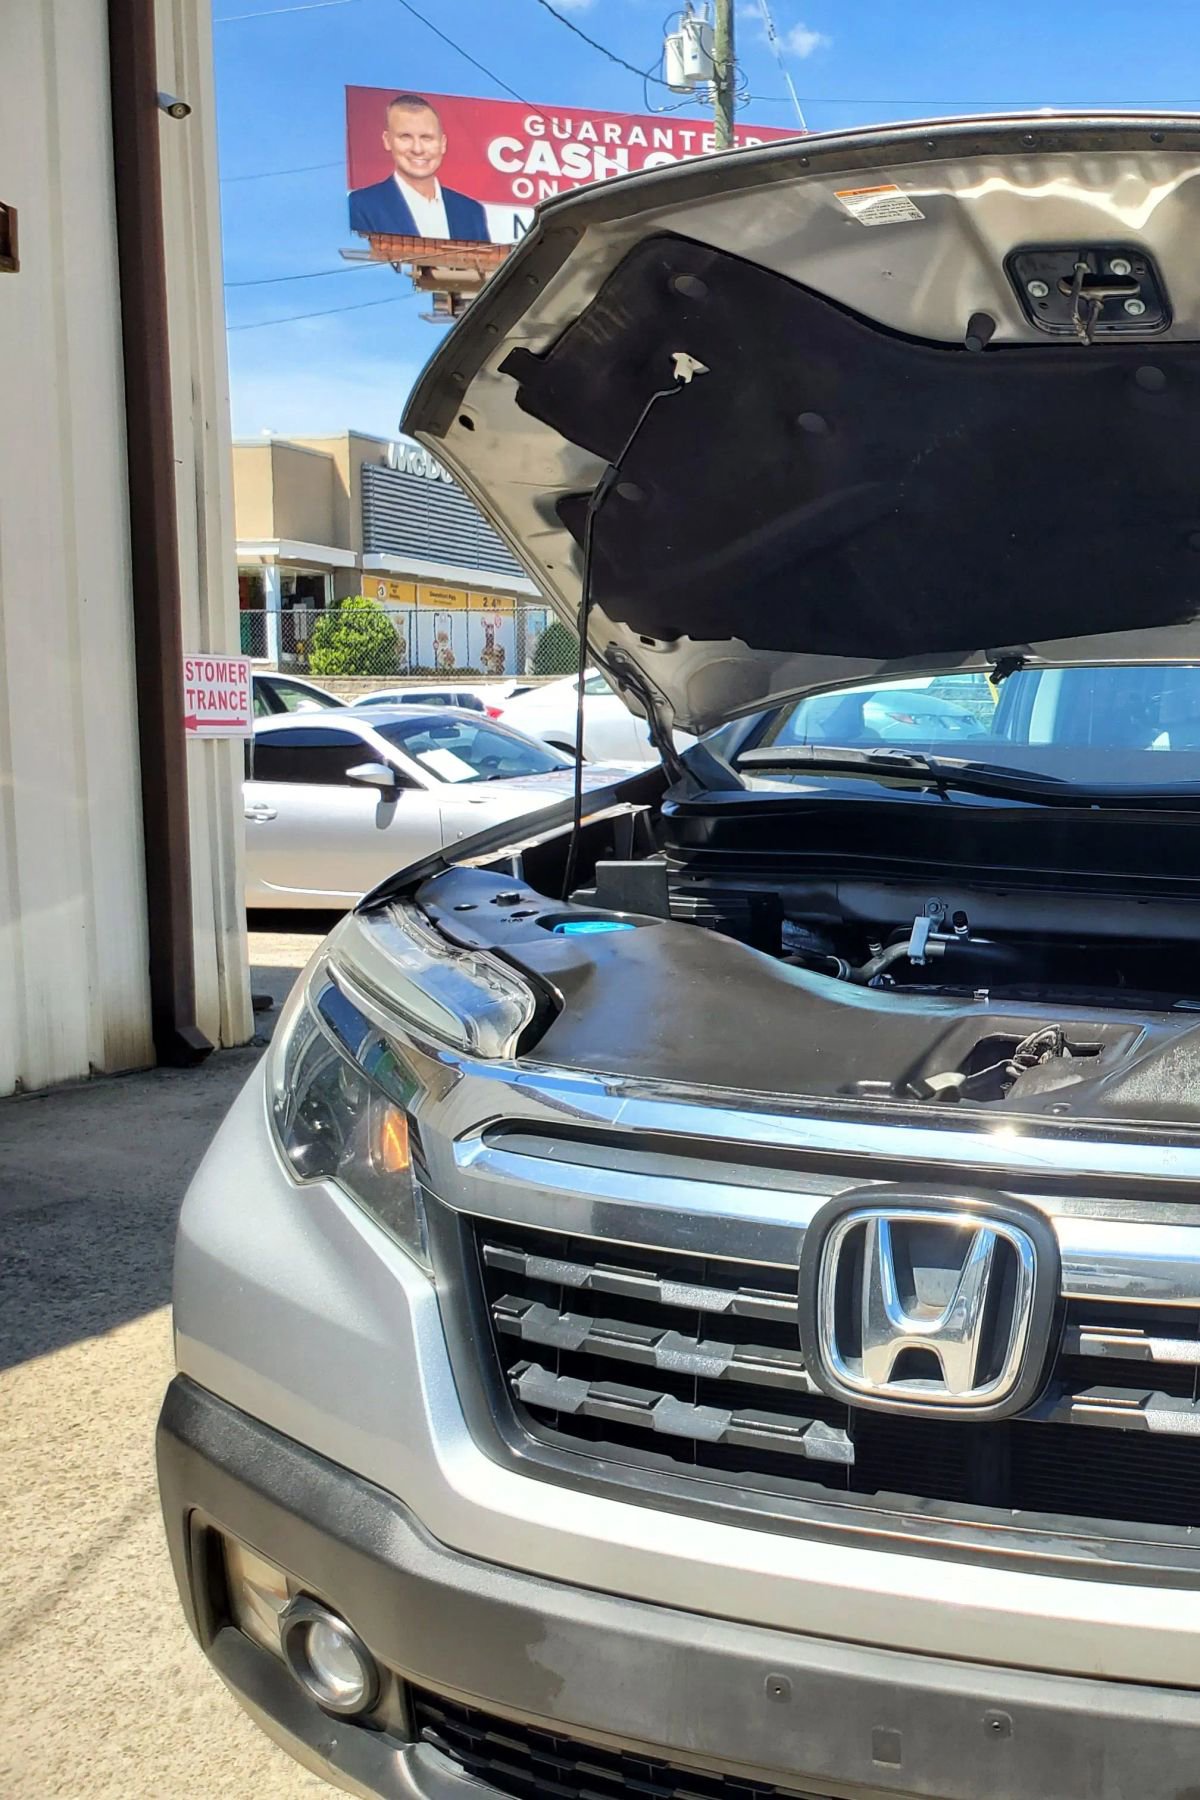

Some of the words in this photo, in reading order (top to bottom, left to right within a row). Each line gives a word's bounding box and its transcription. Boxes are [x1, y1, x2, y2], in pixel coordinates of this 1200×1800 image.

[523, 114, 763, 153] GUARANTE
[487, 136, 629, 179] CASH
[511, 177, 559, 200] ON
[387, 442, 458, 485] McDo
[185, 661, 247, 684] STOMER
[186, 689, 247, 711] TRANCE
